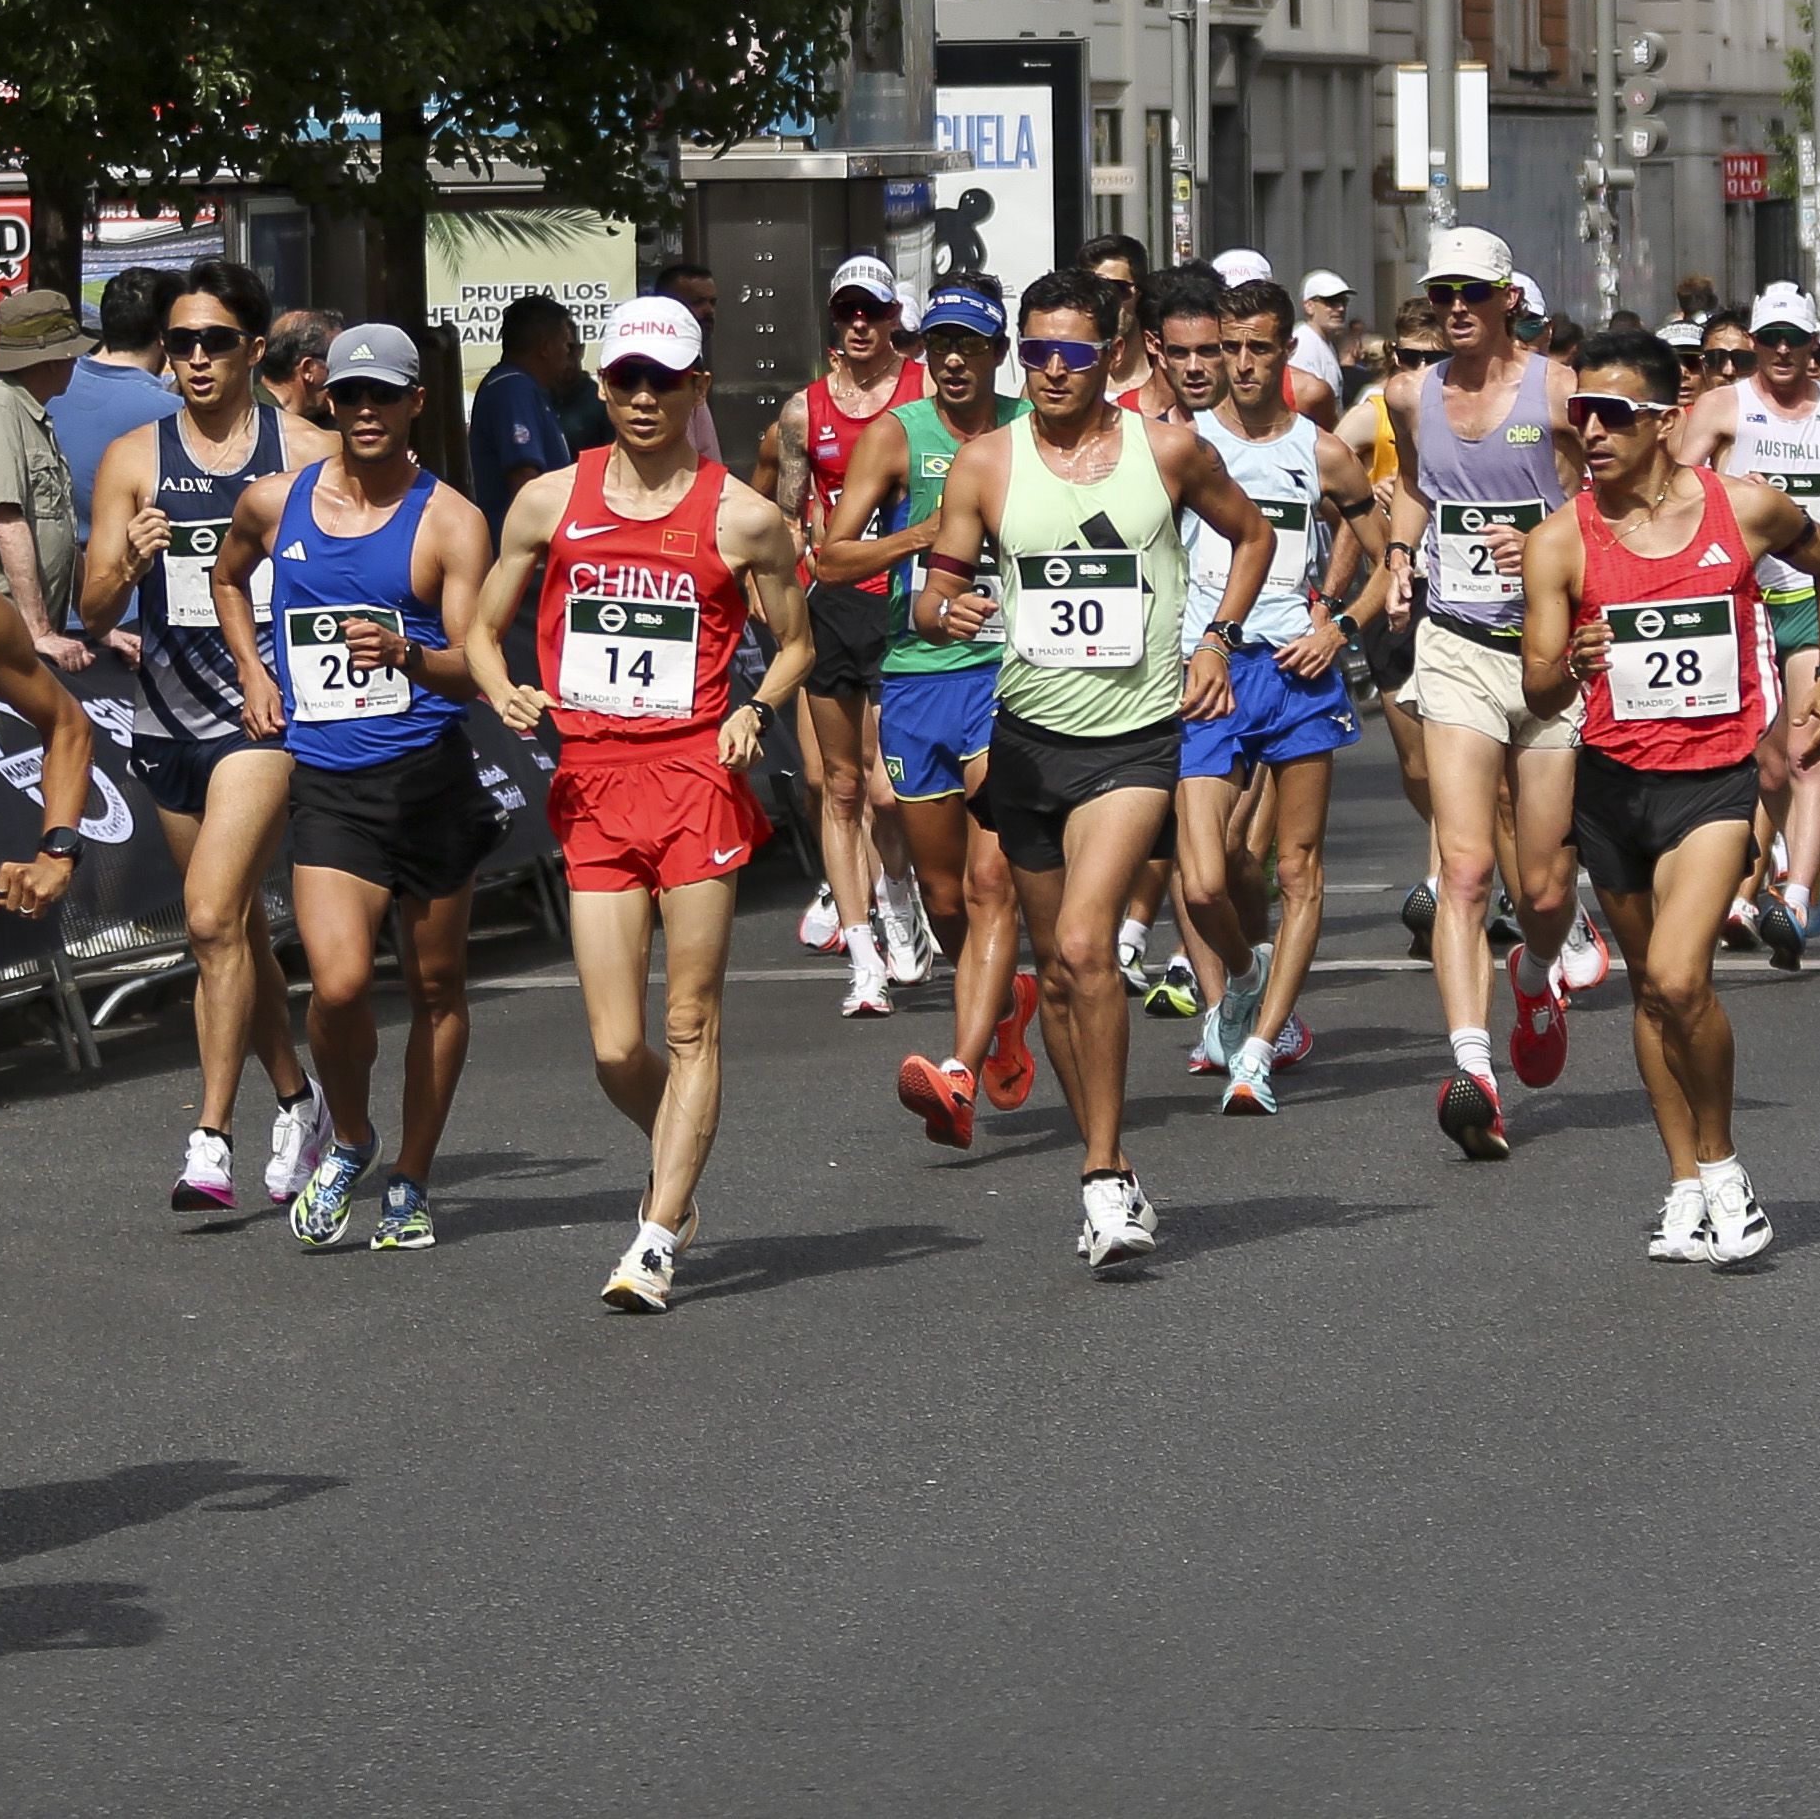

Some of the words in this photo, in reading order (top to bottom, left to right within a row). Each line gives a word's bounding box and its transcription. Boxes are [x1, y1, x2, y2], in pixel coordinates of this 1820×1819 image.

[1727, 159, 1759, 176] UNI
[1727, 180, 1762, 195] QLO
[461, 284, 554, 303] PRUEBA
[563, 283, 608, 301] LOS
[618, 320, 678, 338] CHINA
[1506, 424, 1541, 444] ciele
[160, 476, 213, 494] A.D.W.
[569, 562, 696, 603] CHINA
[1050, 599, 1104, 637] 30
[605, 646, 655, 688] 14
[1645, 648, 1702, 689] 28
